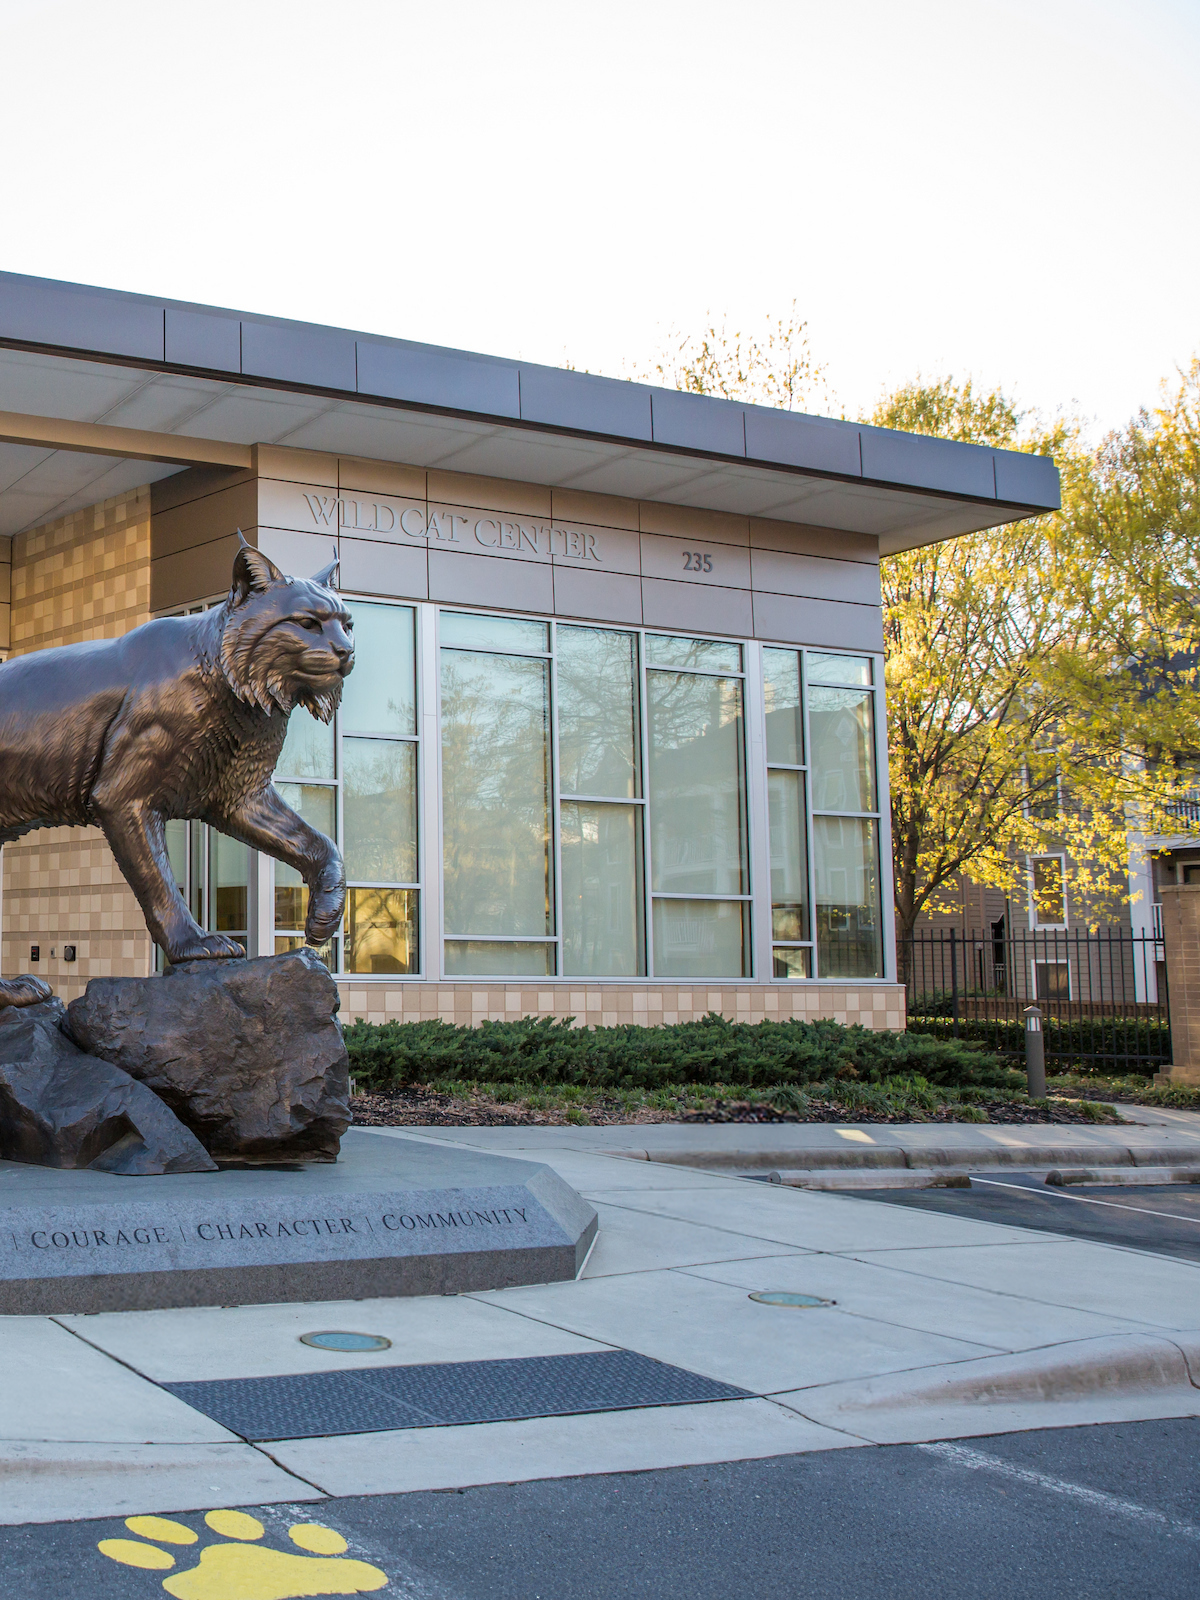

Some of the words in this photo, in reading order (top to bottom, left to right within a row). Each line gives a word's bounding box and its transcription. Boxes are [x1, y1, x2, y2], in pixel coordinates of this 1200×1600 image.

[303, 493, 464, 543] WILDCAT
[474, 518, 603, 562] CENTER
[682, 551, 714, 573] 235
[30, 1227, 170, 1250] COURAGE
[197, 1217, 358, 1242] CHARACTER
[381, 1208, 528, 1232] COMMUNITY
